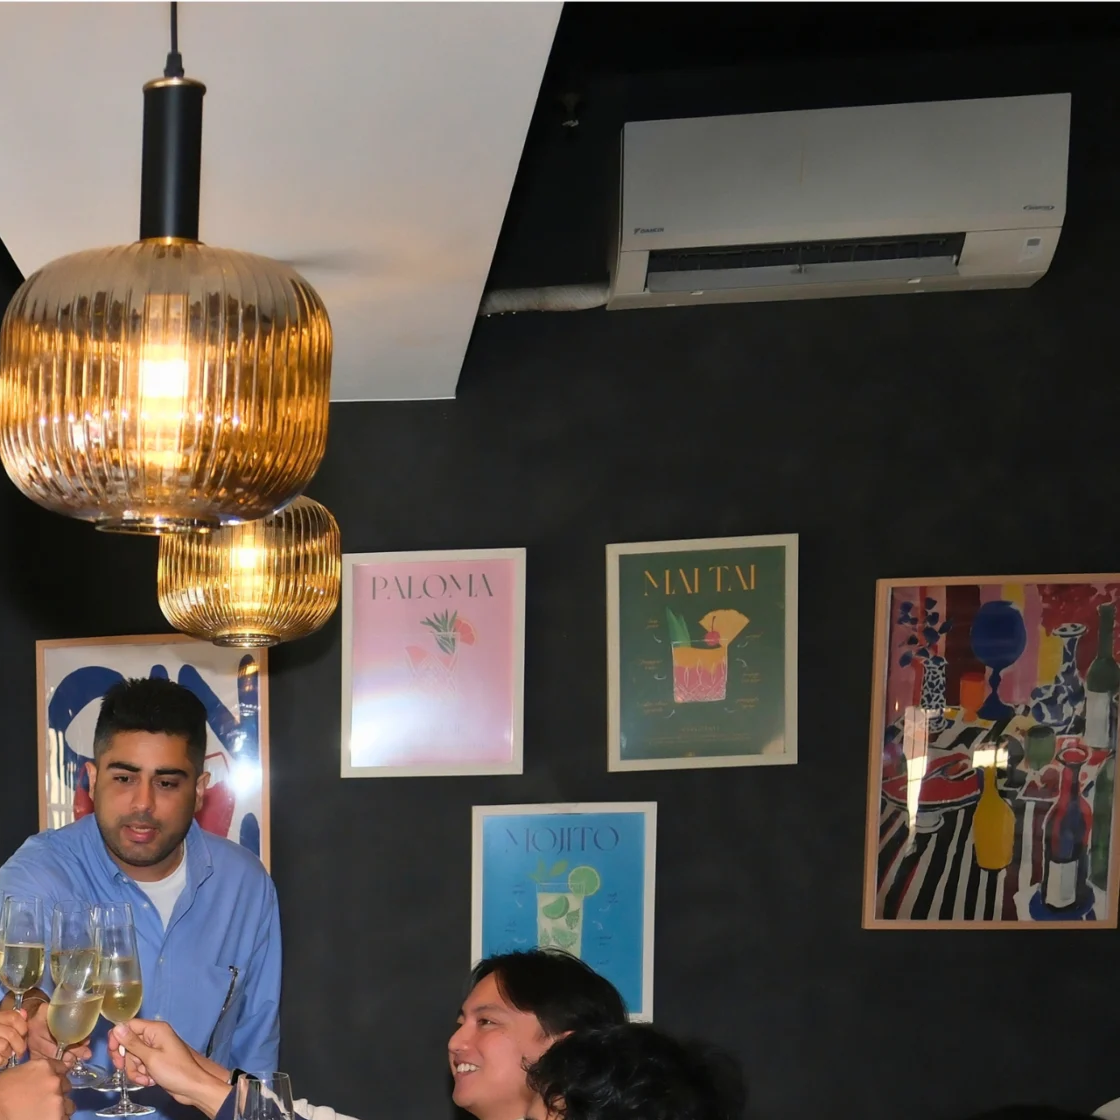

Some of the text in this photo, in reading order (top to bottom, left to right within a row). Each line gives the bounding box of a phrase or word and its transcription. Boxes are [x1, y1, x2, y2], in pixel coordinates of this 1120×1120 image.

[371, 573, 494, 600] PALOMA
[643, 564, 756, 596] MAI TAI
[505, 826, 620, 855] MOJITO
